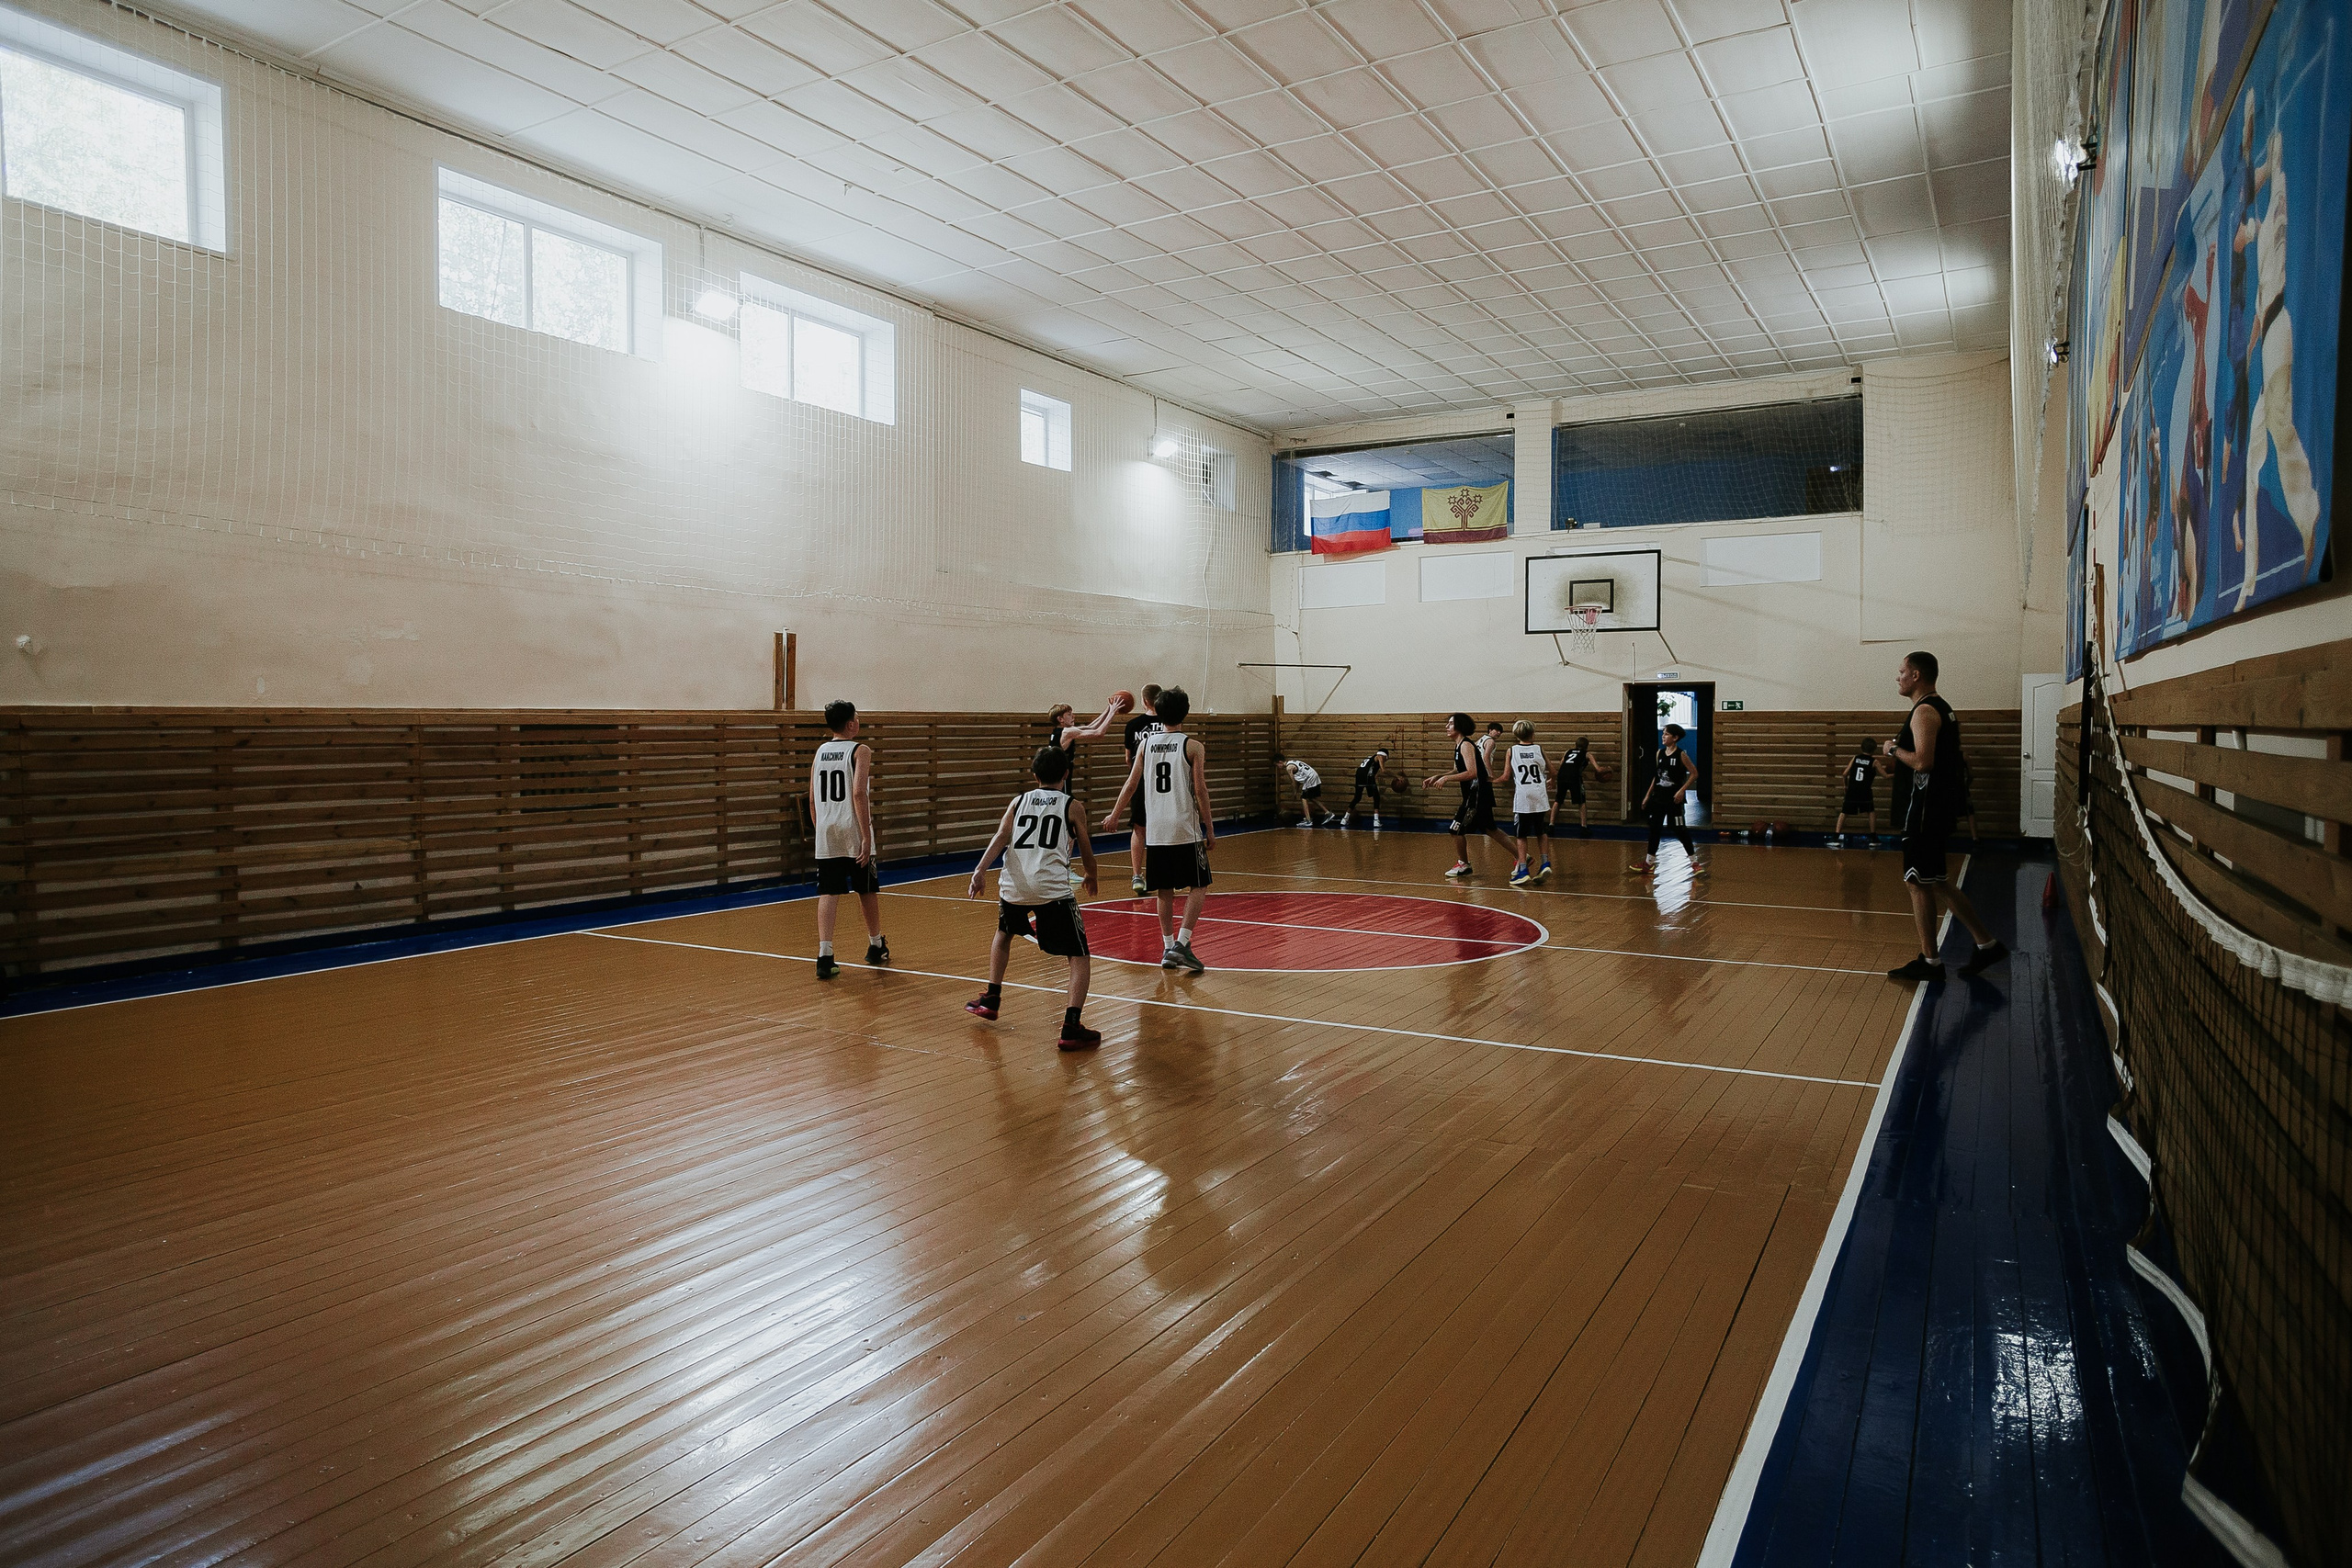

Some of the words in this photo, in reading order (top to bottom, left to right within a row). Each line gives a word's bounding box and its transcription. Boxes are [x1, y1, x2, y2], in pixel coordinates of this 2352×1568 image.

[1150, 722, 1163, 731] TH
[1566, 753, 1577, 763] 2
[1156, 761, 1171, 793] 8
[1518, 764, 1542, 785] 29
[1855, 767, 1864, 781] 6
[820, 769, 845, 802] 10
[1013, 814, 1062, 850] 20
[1450, 819, 1461, 831] 16
